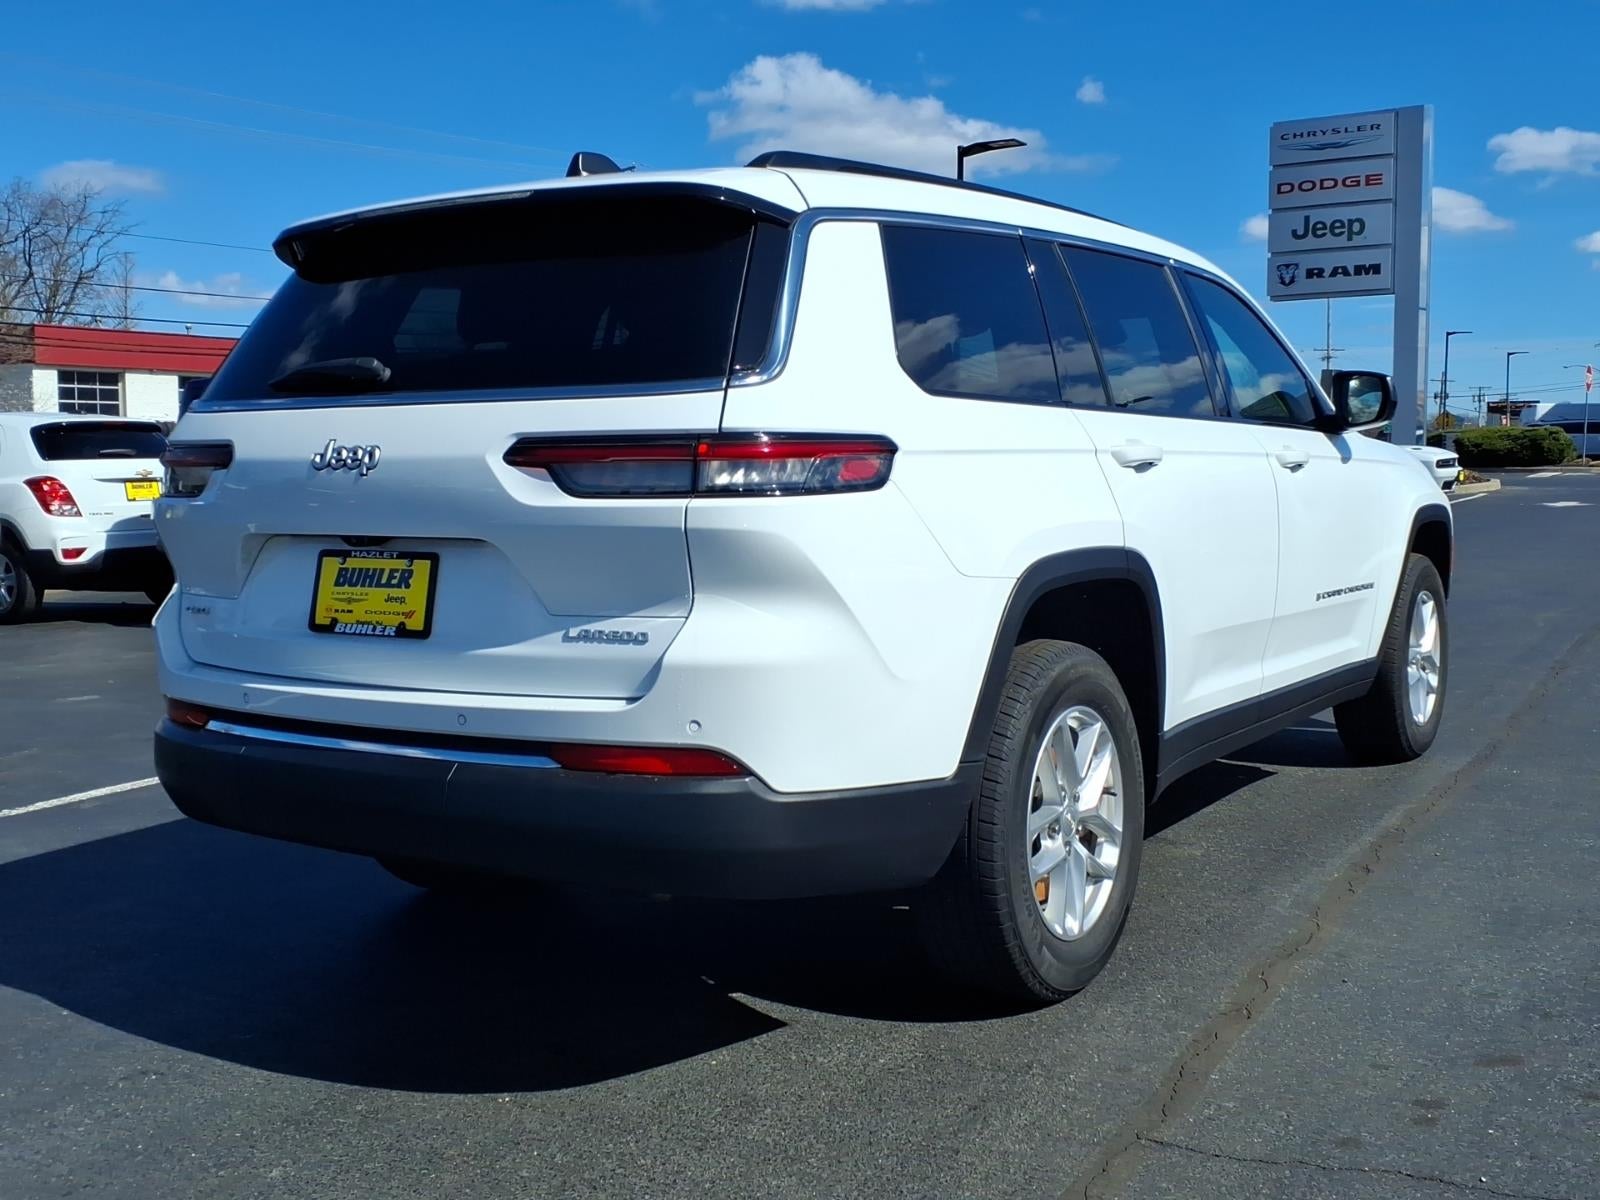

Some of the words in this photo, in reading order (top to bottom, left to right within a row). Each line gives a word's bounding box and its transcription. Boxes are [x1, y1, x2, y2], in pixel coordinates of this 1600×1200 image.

[1280, 123, 1382, 141] CHRYSLER
[1276, 173, 1384, 195] DODGE
[1291, 215, 1367, 242] Jeep
[1305, 263, 1382, 280] RAM
[312, 439, 381, 477] Jeep
[351, 550, 399, 559] HAZLET
[333, 567, 414, 590] BUHLER
[384, 592, 406, 606] Jeep
[334, 607, 354, 615] RAM
[364, 609, 408, 617] DODGE
[334, 622, 397, 637] BUHLER
[561, 627, 649, 646] LAREDO
